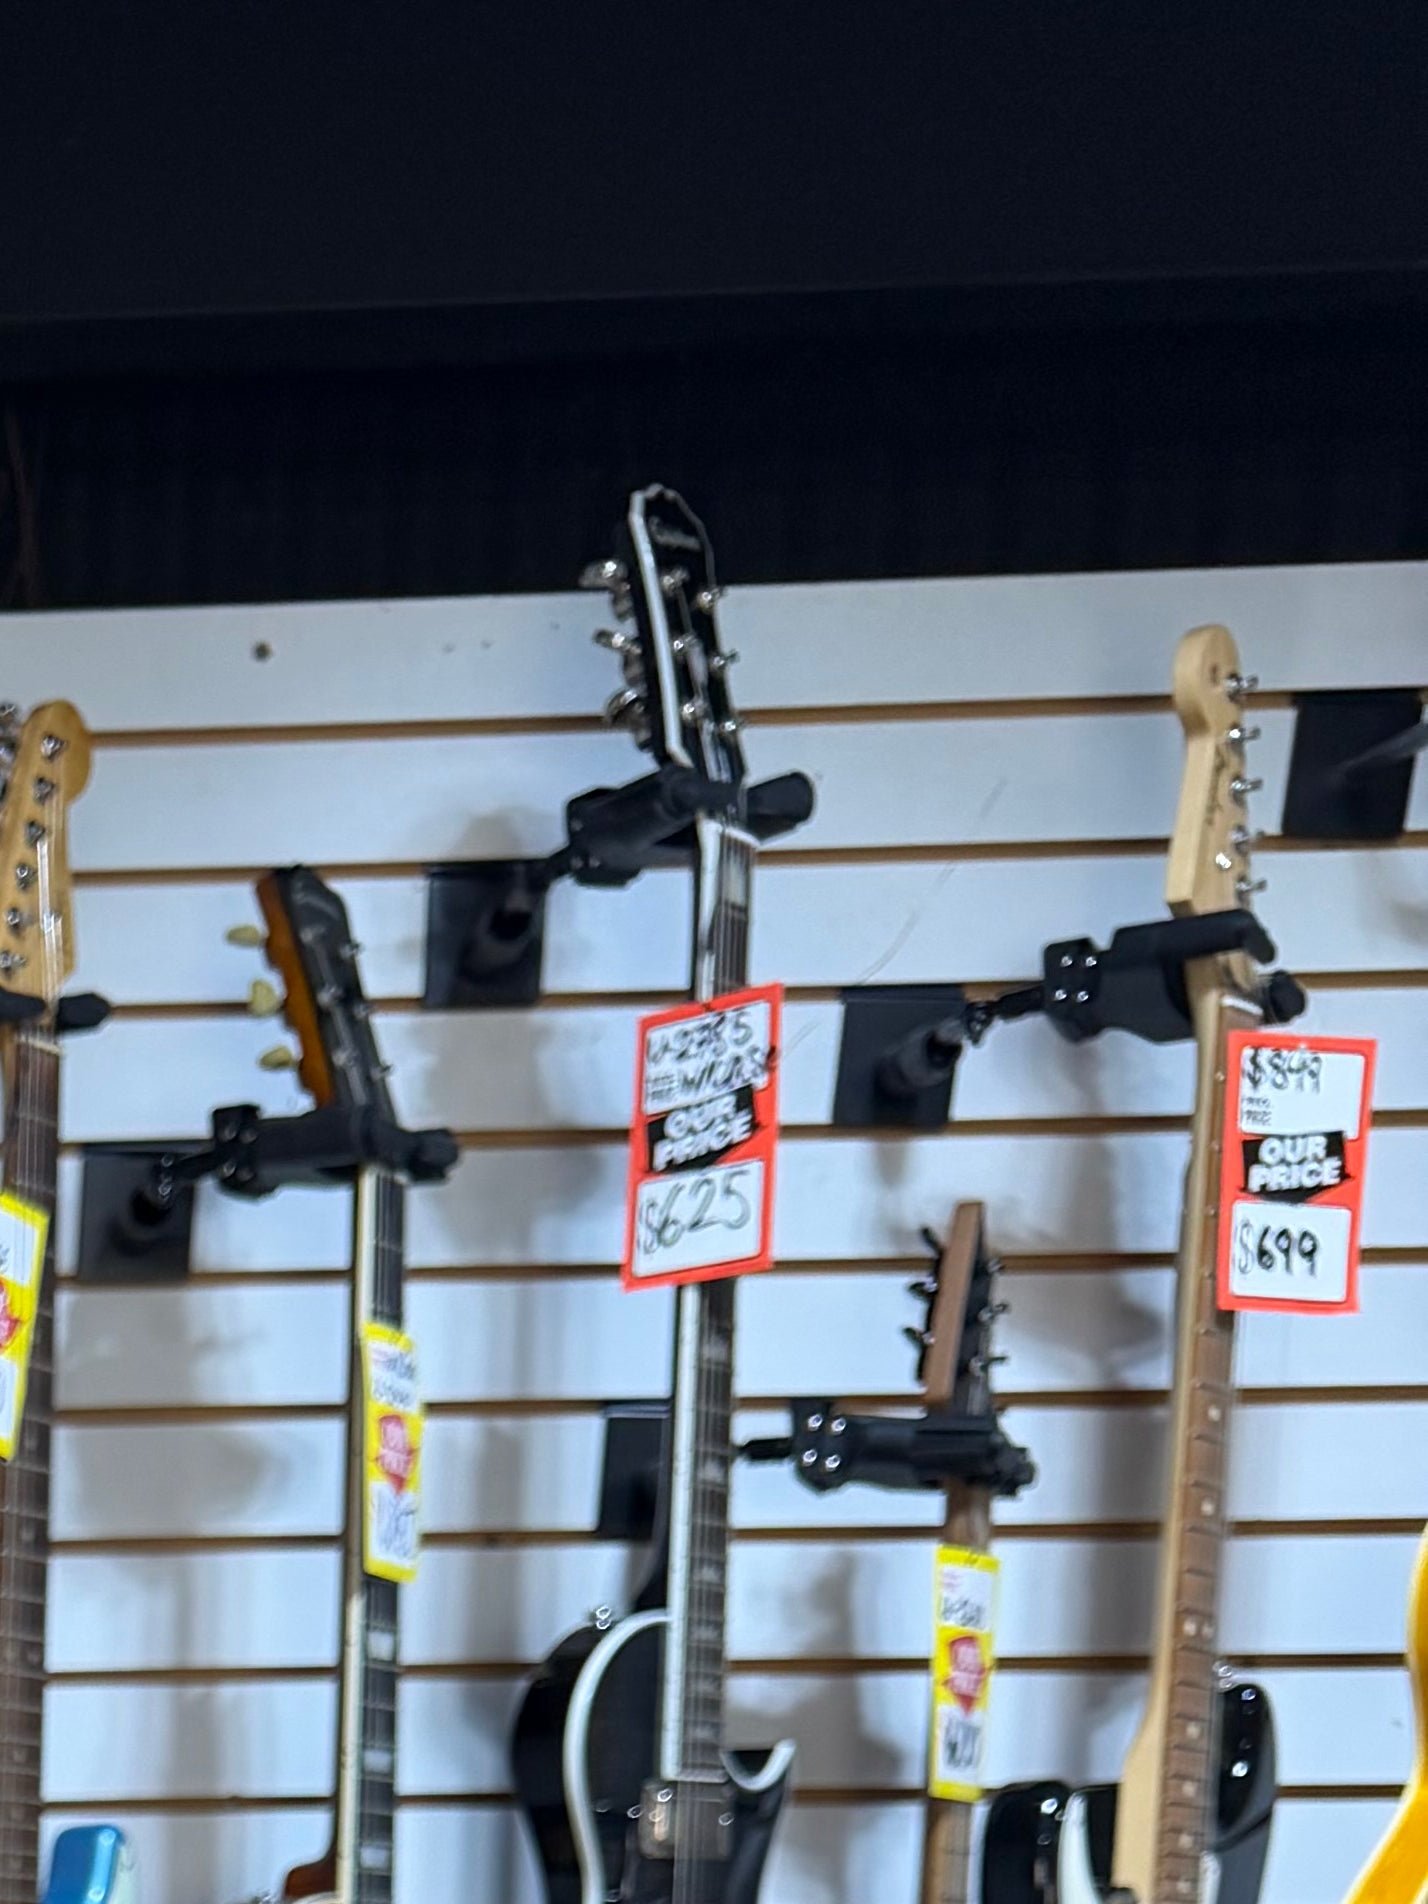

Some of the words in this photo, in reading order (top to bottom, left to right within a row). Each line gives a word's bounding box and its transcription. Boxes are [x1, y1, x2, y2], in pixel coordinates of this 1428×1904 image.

[1259, 1136, 1328, 1165] OUR
[1247, 1157, 1342, 1193] PRICE
[1235, 1218, 1319, 1279] $699
